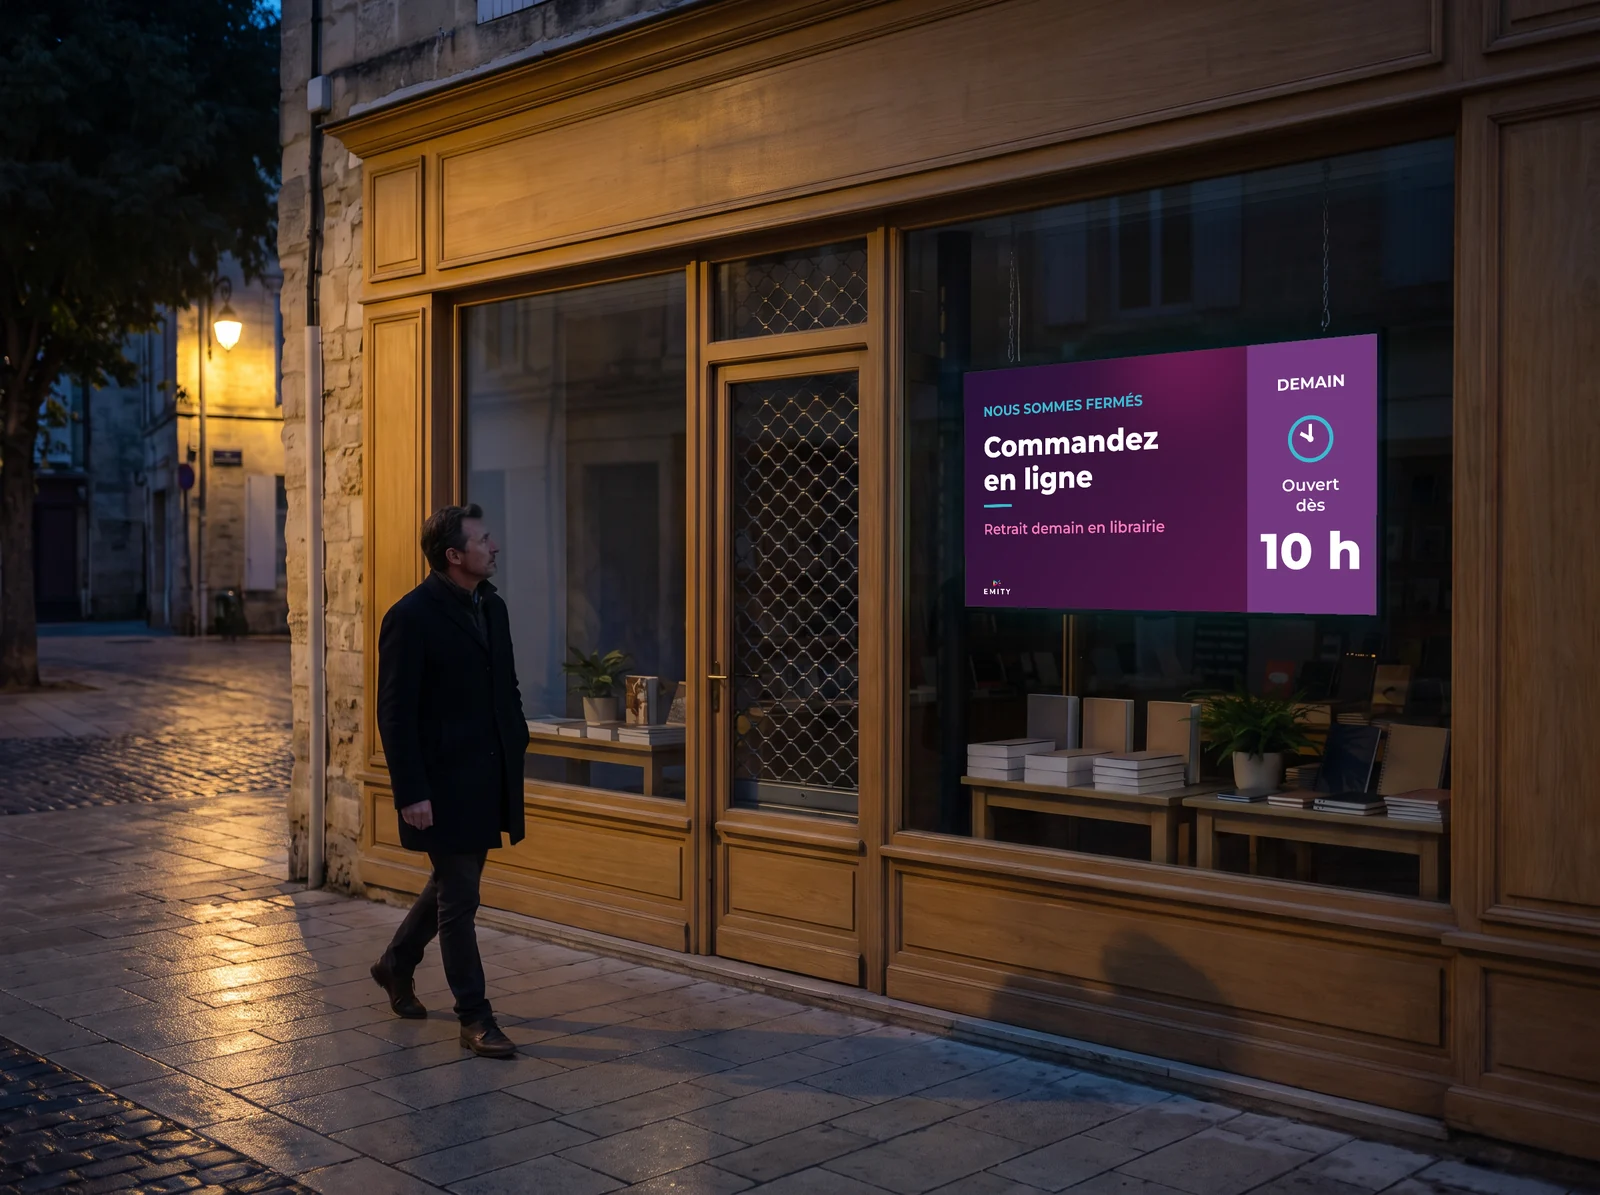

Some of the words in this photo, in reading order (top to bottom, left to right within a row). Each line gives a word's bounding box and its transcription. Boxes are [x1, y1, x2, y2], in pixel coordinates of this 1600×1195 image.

[1277, 373, 1345, 392] DEMAIN
[983, 403, 1021, 418] NOUS
[1023, 398, 1083, 415] SOMMES
[1085, 392, 1143, 411] FERMÉS
[983, 426, 1159, 459] Commandez
[983, 473, 1016, 492] en
[1024, 464, 1093, 496] ligne
[1282, 478, 1340, 493] Ouvert
[1295, 497, 1326, 513] dès
[984, 521, 1028, 536] Retrait
[1031, 520, 1084, 535] demain
[1087, 523, 1106, 534] en
[1110, 519, 1166, 534] librairie
[1260, 532, 1312, 571] 10
[1329, 530, 1361, 570] h
[983, 588, 1011, 596] EMITY
